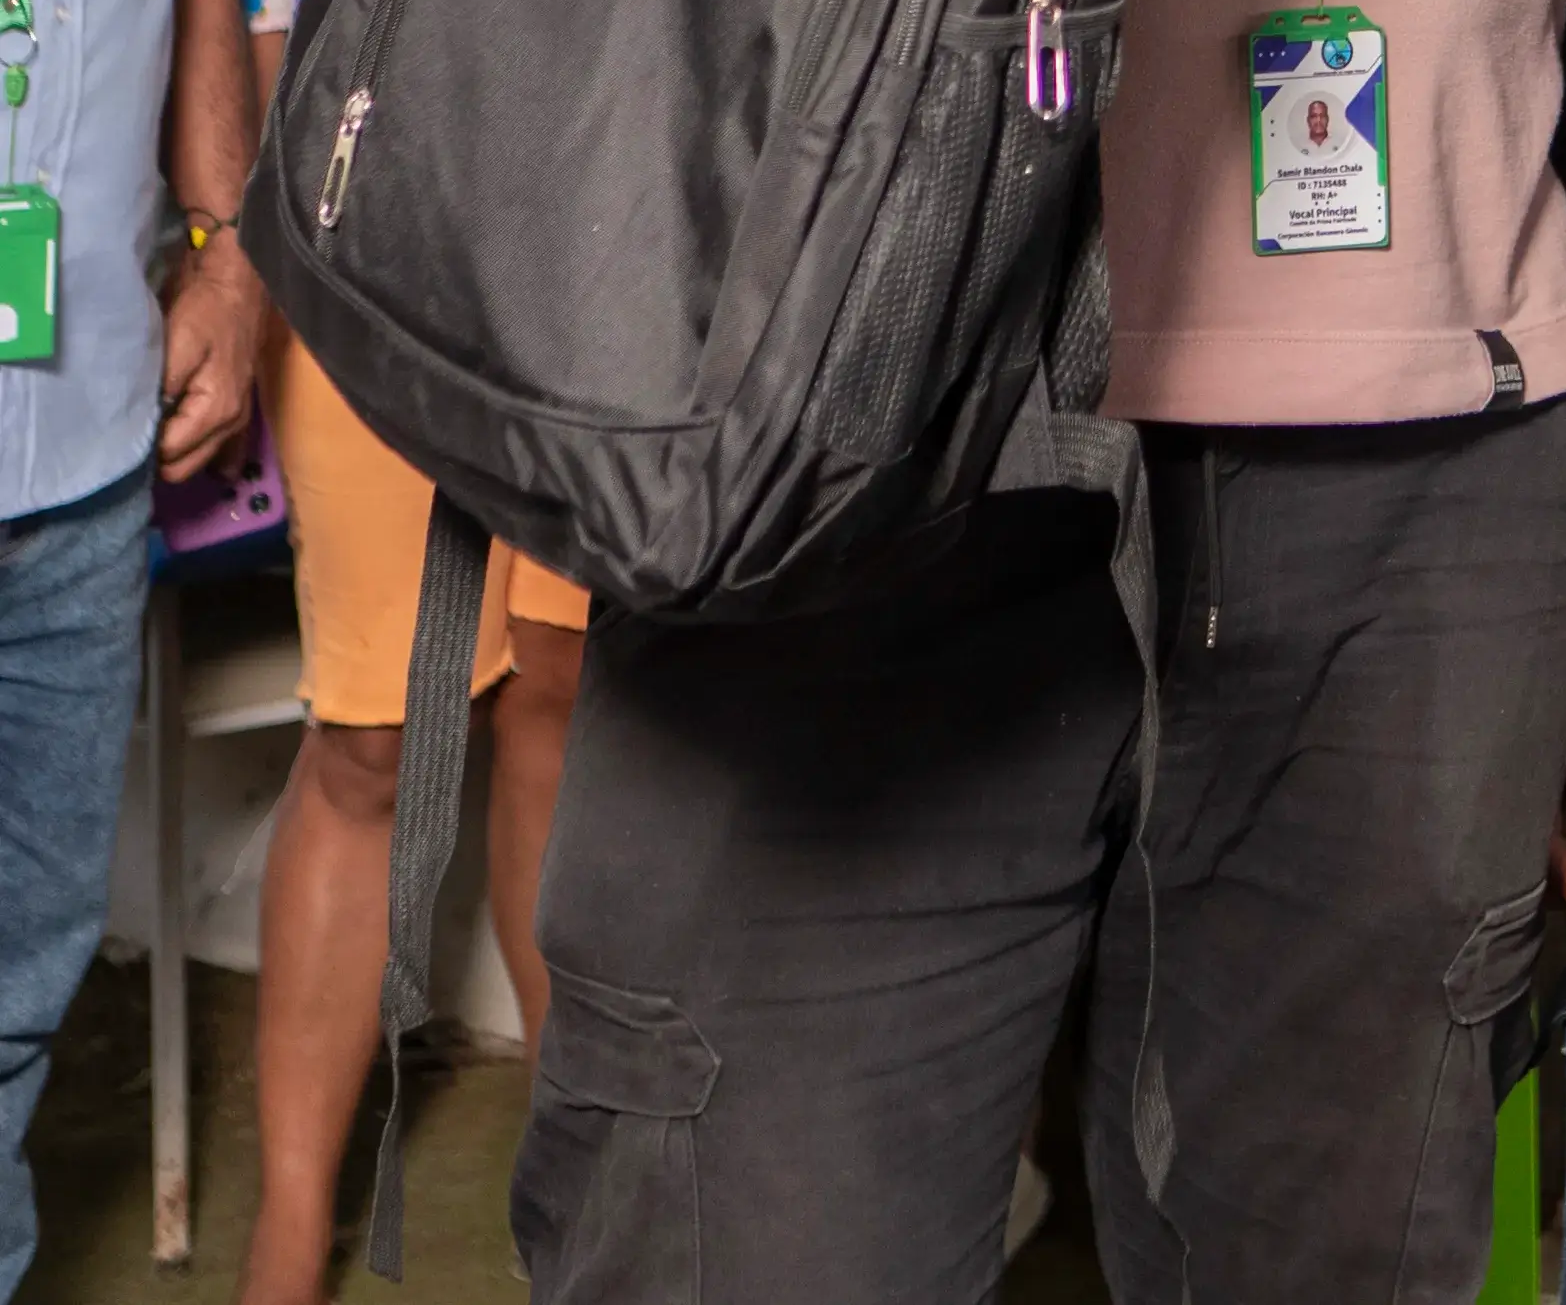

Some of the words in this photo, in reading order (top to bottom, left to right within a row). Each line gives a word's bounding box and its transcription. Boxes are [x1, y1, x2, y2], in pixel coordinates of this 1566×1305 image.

[1297, 181, 1307, 191] ID
[1289, 208, 1314, 220] Vocal
[1316, 205, 1358, 218] Principal
